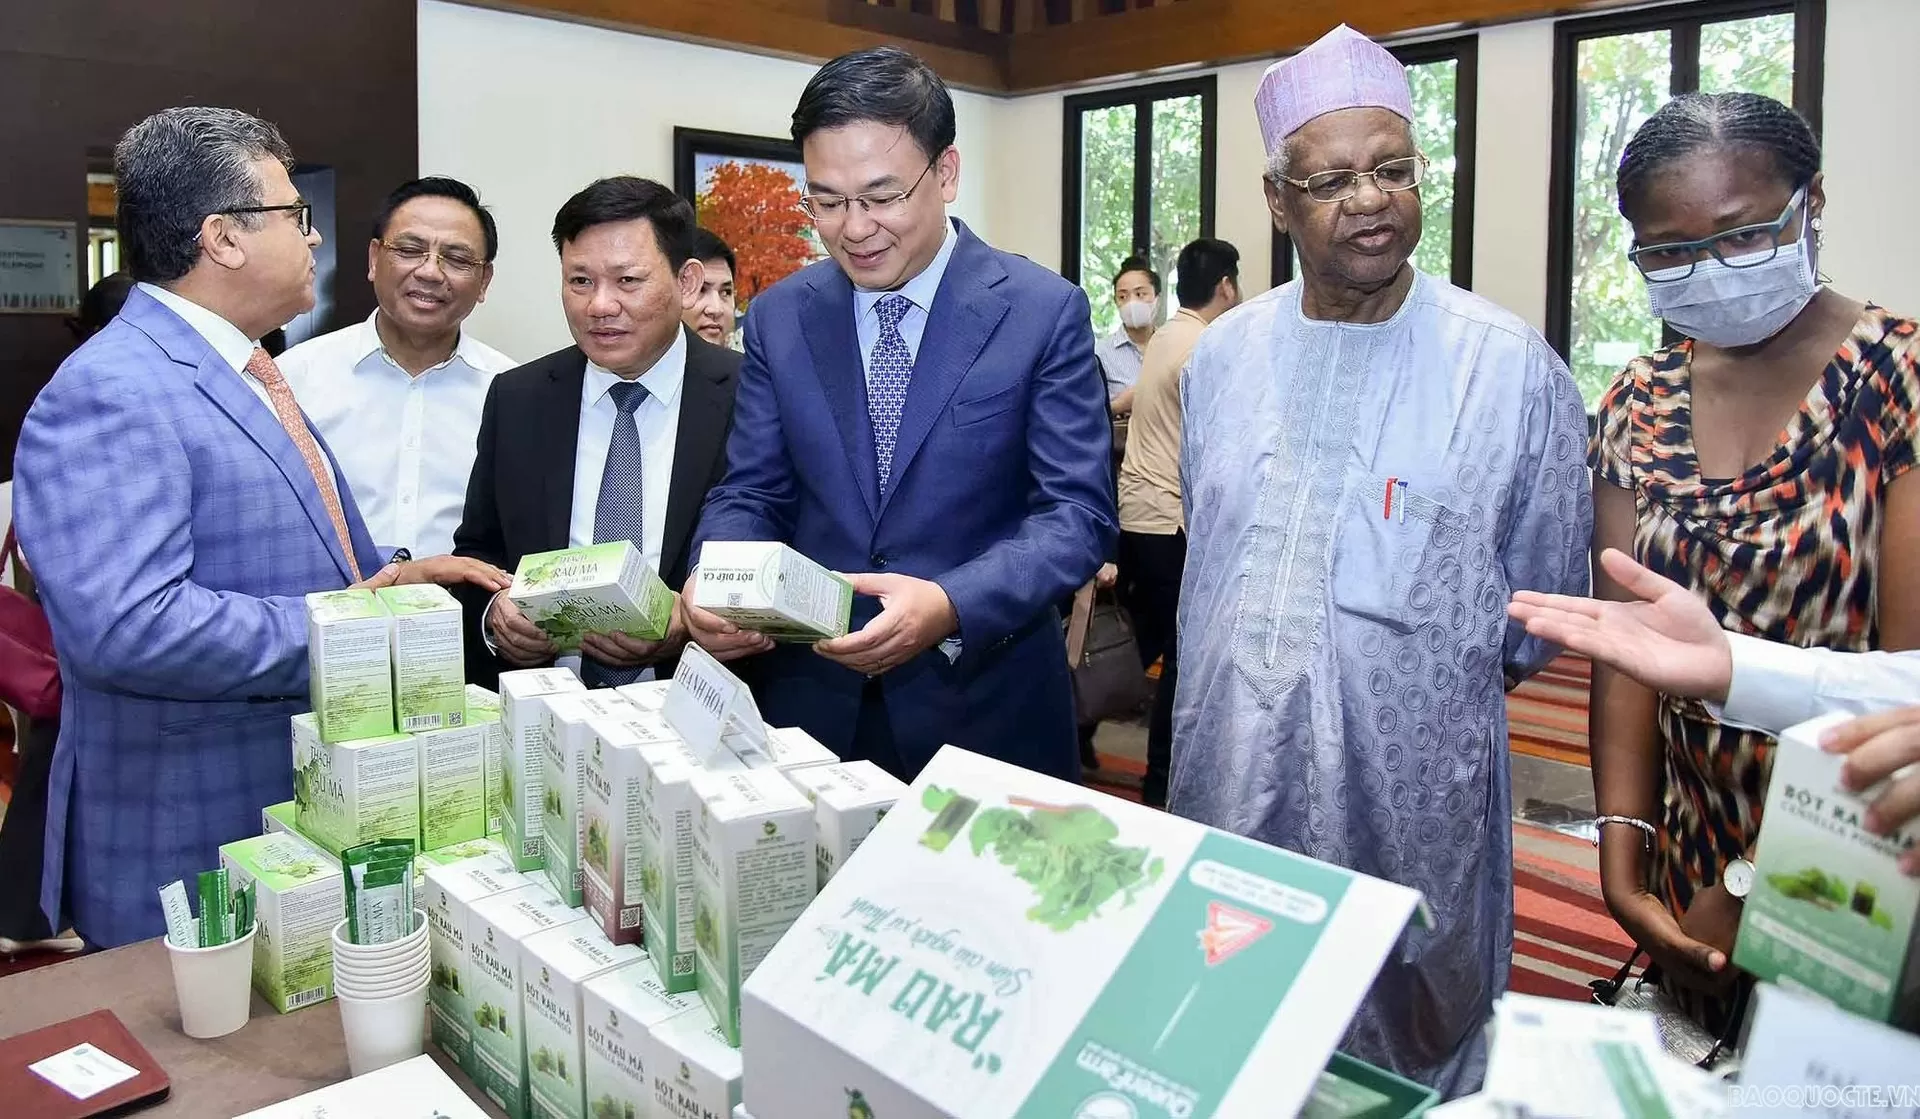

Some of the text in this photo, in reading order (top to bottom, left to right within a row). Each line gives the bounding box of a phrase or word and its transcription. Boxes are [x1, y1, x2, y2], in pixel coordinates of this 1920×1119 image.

[675, 660, 707, 700] THANH
[329, 777, 345, 804] MÁ
[1833, 805, 1858, 827] RA
[485, 953, 500, 972] RAU
[541, 994, 557, 1014] RAU
[814, 932, 1003, 1054] RAU MÁ
[607, 1039, 626, 1061] RAU
[677, 1091, 700, 1117] RAU
